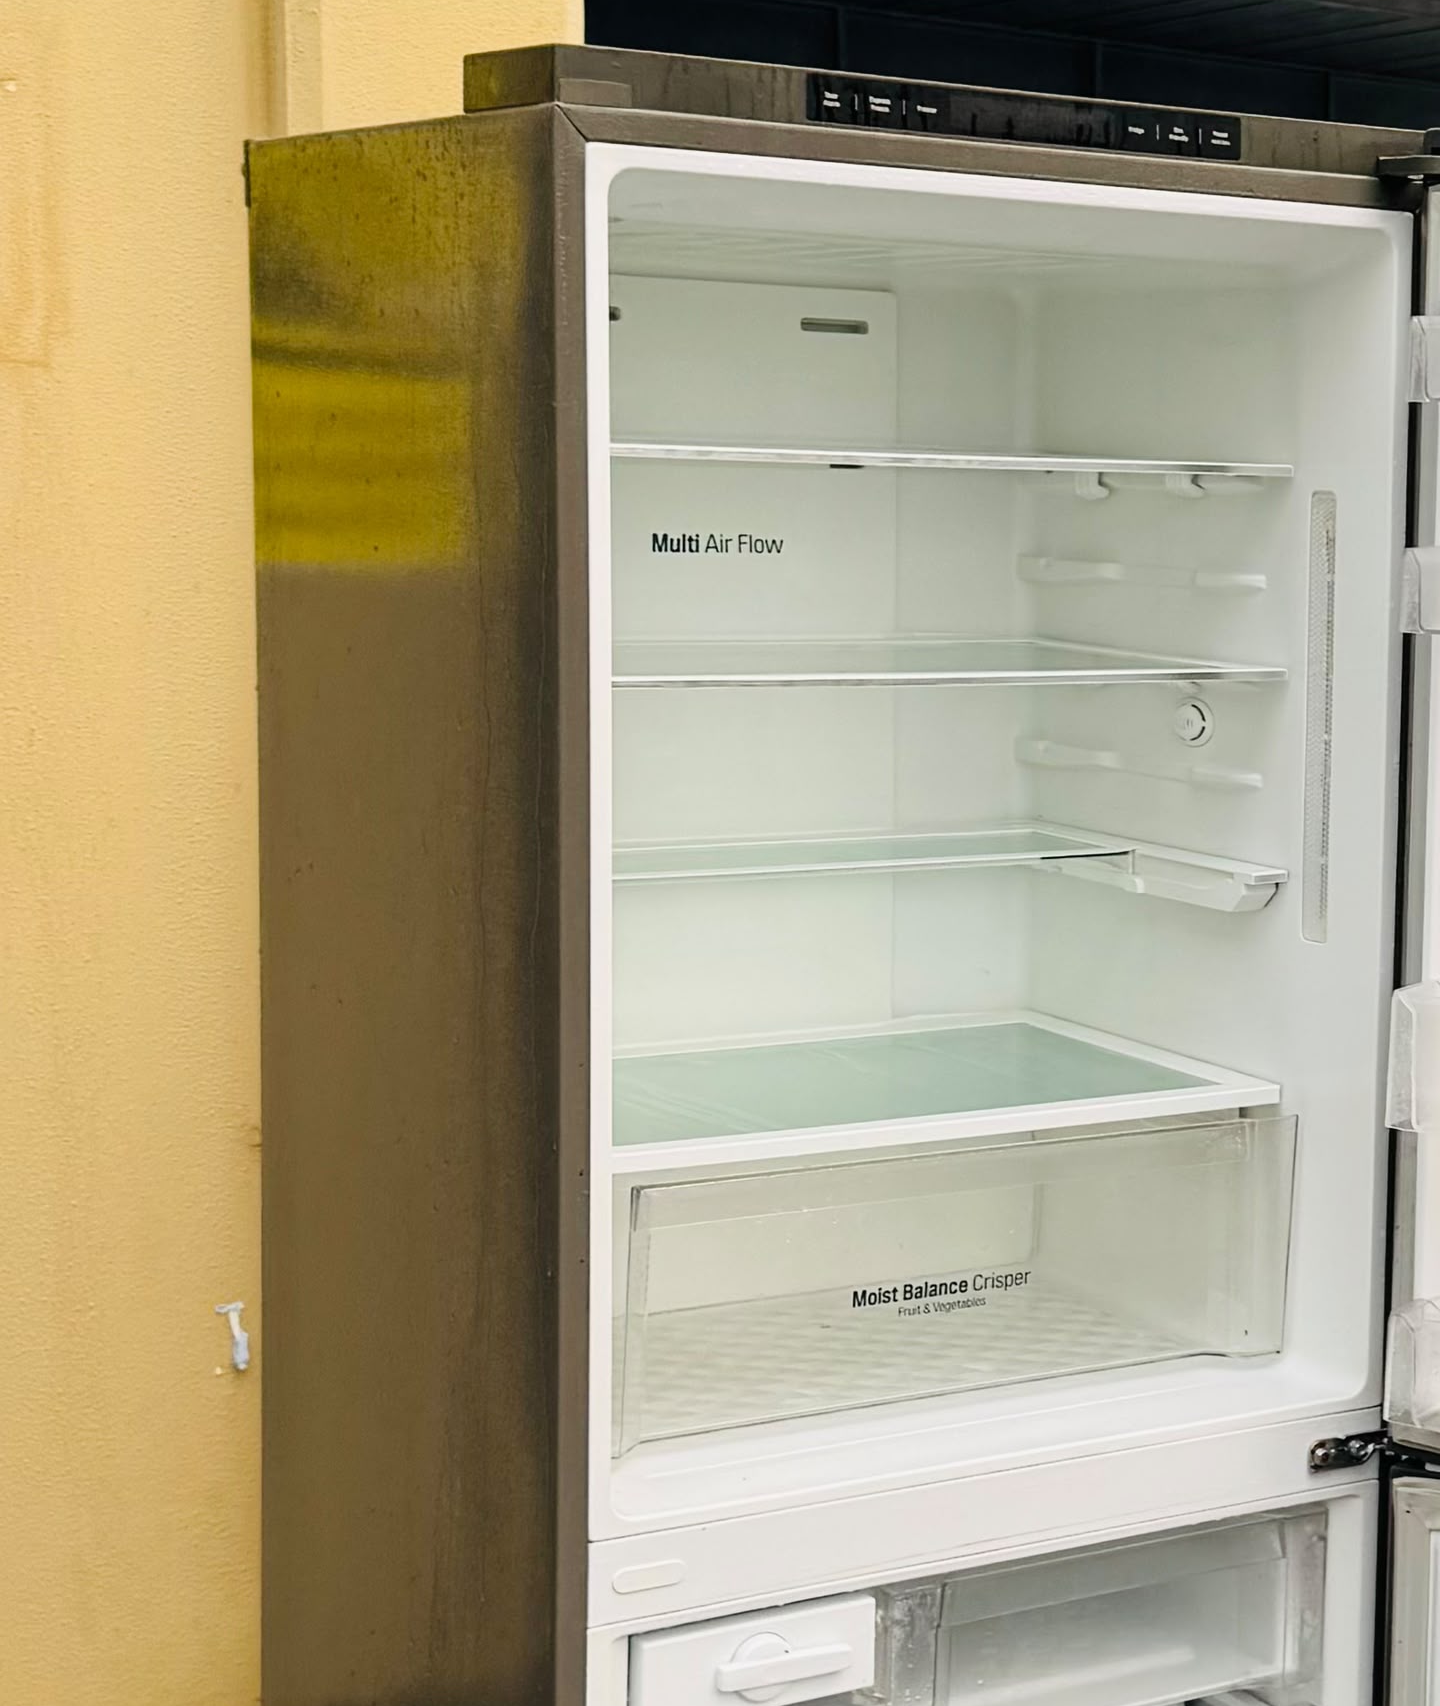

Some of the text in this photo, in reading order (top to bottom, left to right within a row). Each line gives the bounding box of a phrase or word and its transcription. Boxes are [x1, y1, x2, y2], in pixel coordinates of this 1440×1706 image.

[652, 533, 783, 554] Multi Air Flow
[852, 1270, 1031, 1308] Moist Balance Crisper
[898, 1305, 921, 1317] Fruit
[923, 1303, 931, 1314] &
